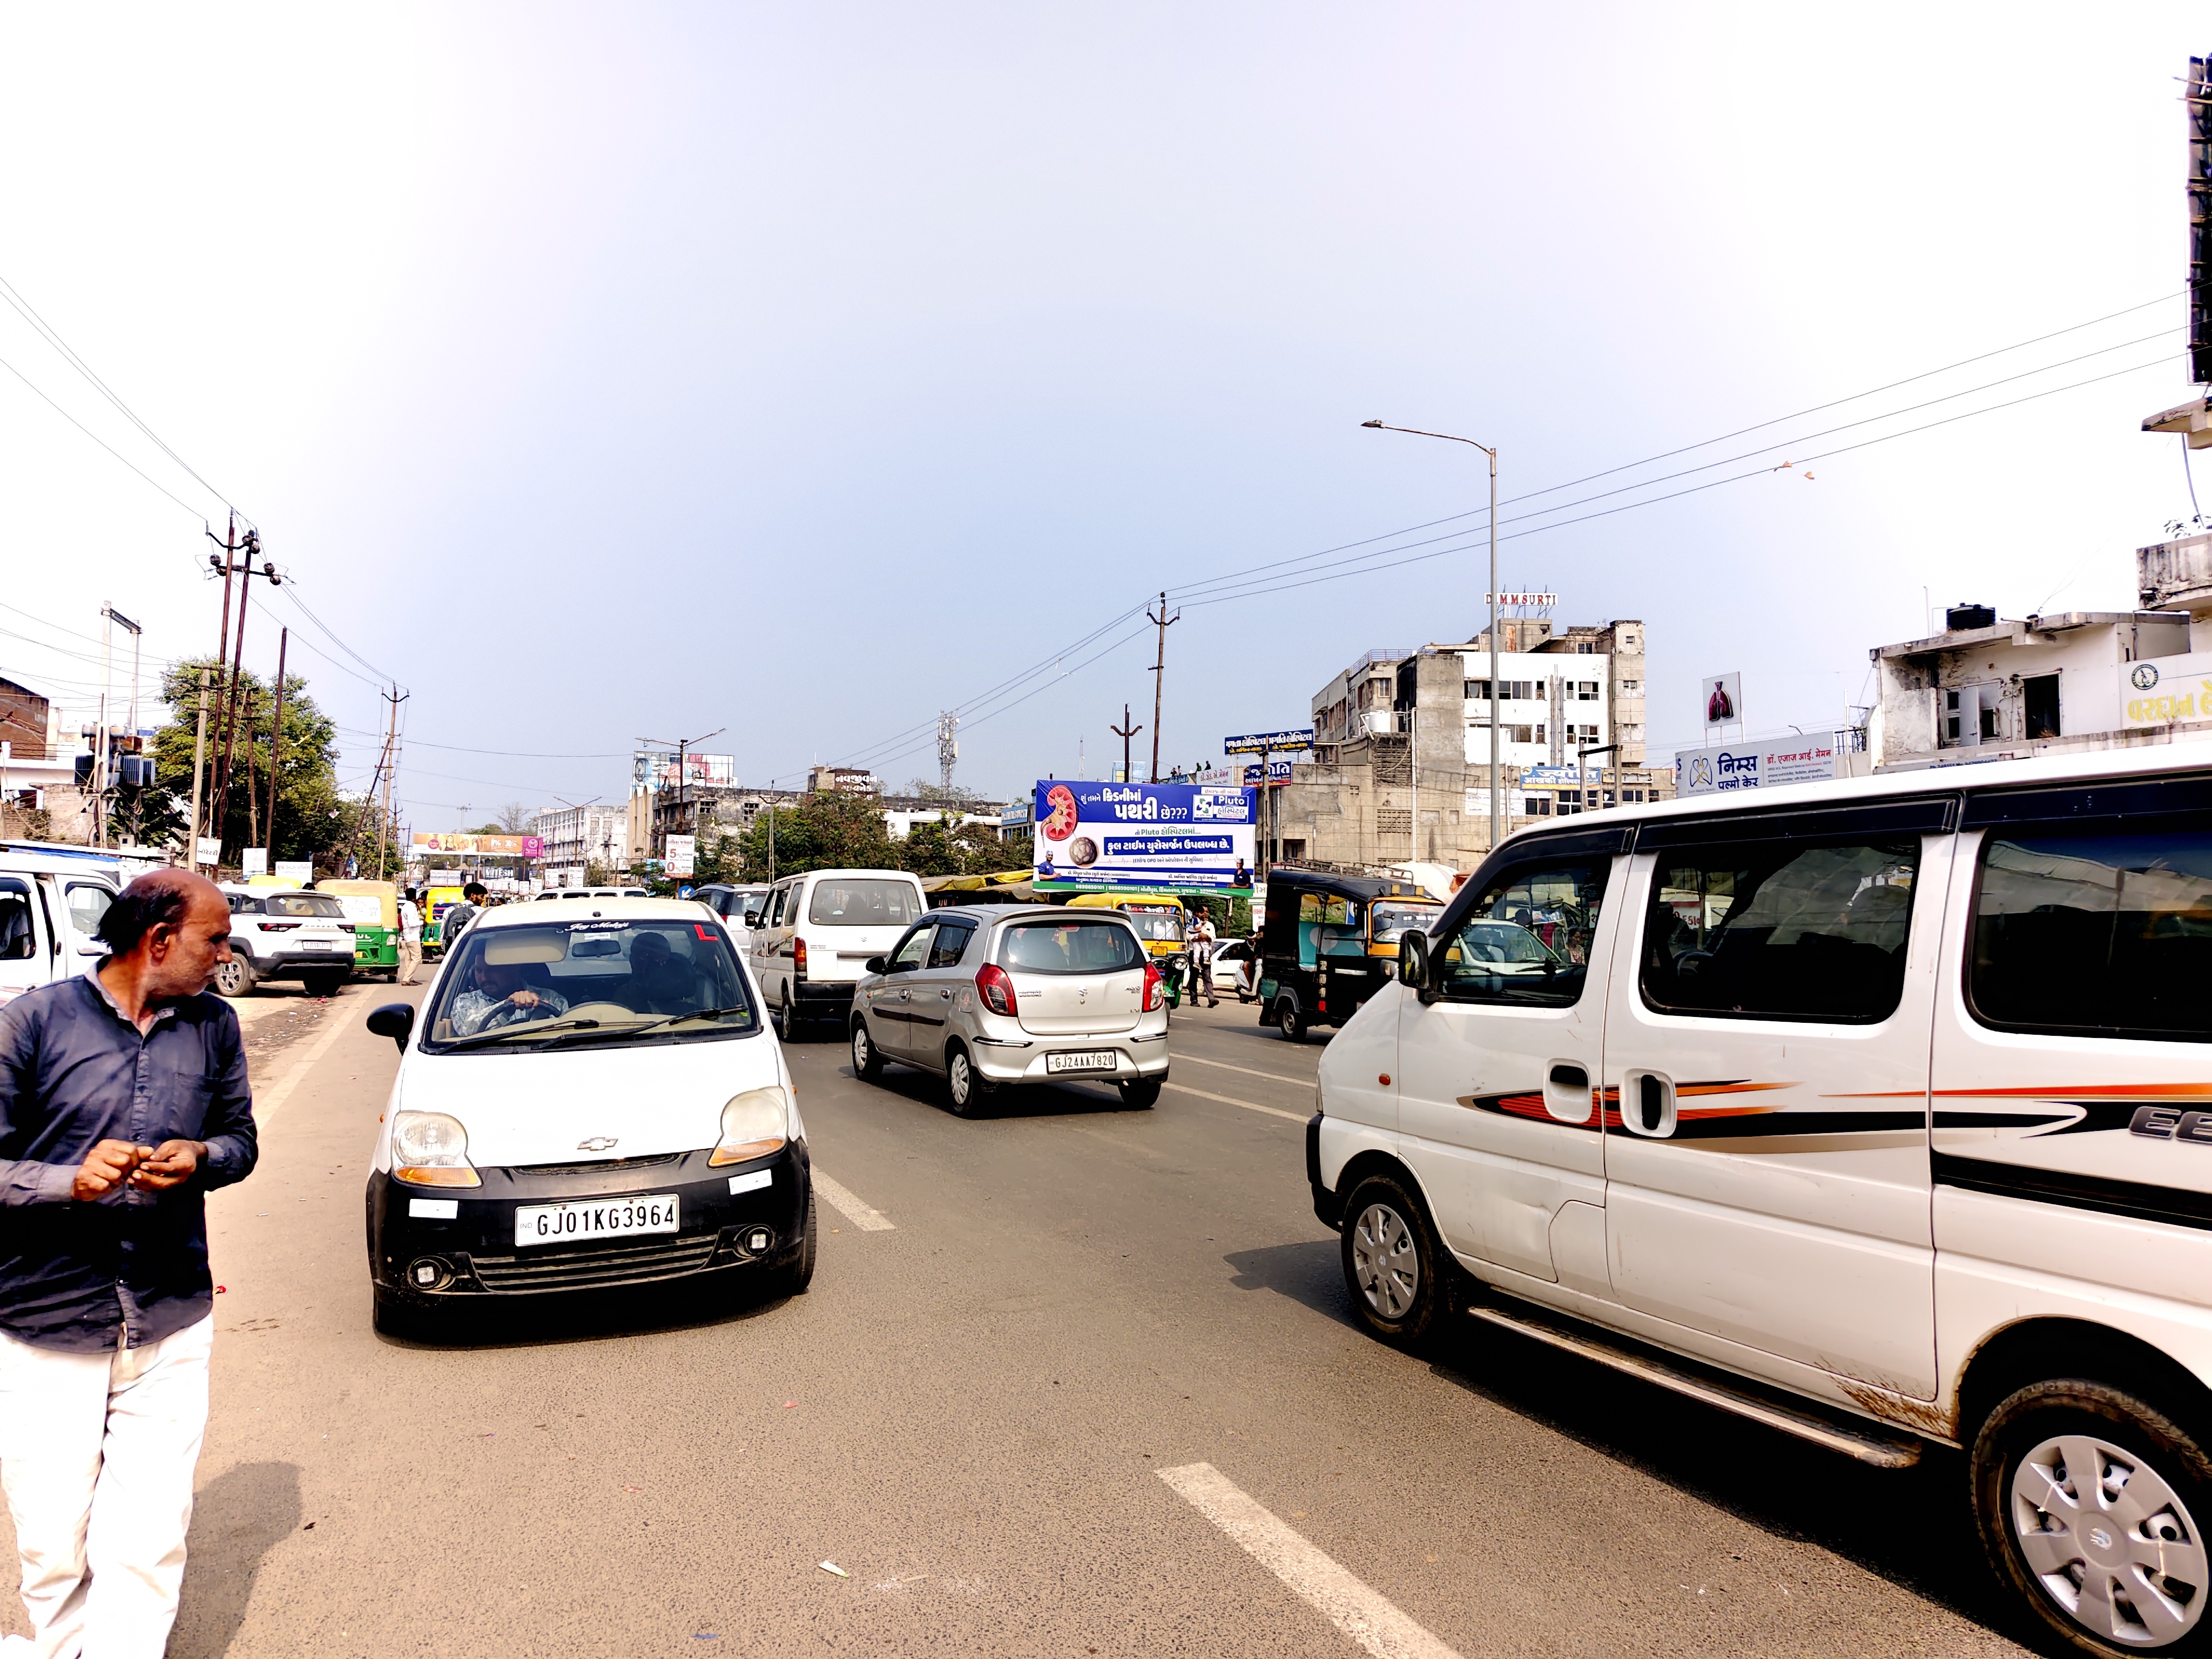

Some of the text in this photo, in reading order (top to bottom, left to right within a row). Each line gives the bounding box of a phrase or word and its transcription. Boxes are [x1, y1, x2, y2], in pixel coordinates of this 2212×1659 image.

[2128, 693, 2195, 722] વરદાન
[1815, 748, 1831, 758] मेमन
[1717, 753, 1757, 775] निम्स
[835, 775, 878, 783] નવજીવન
[1718, 776, 1739, 790] पल्मो
[1742, 775, 1758, 787] केर
[1088, 793, 1101, 801] તમને
[1103, 788, 1141, 802] કિડનીમાં
[1219, 796, 1244, 805] Pluto
[1114, 797, 1188, 820] પથરી છે???
[1108, 838, 1230, 855] ફુલ ટાઈમ યુરોસર્જન ઉપલબ્ધ છે.
[1055, 1054, 1114, 1068] GJ24AA7820
[537, 1203, 674, 1236] GJ01KG3964
